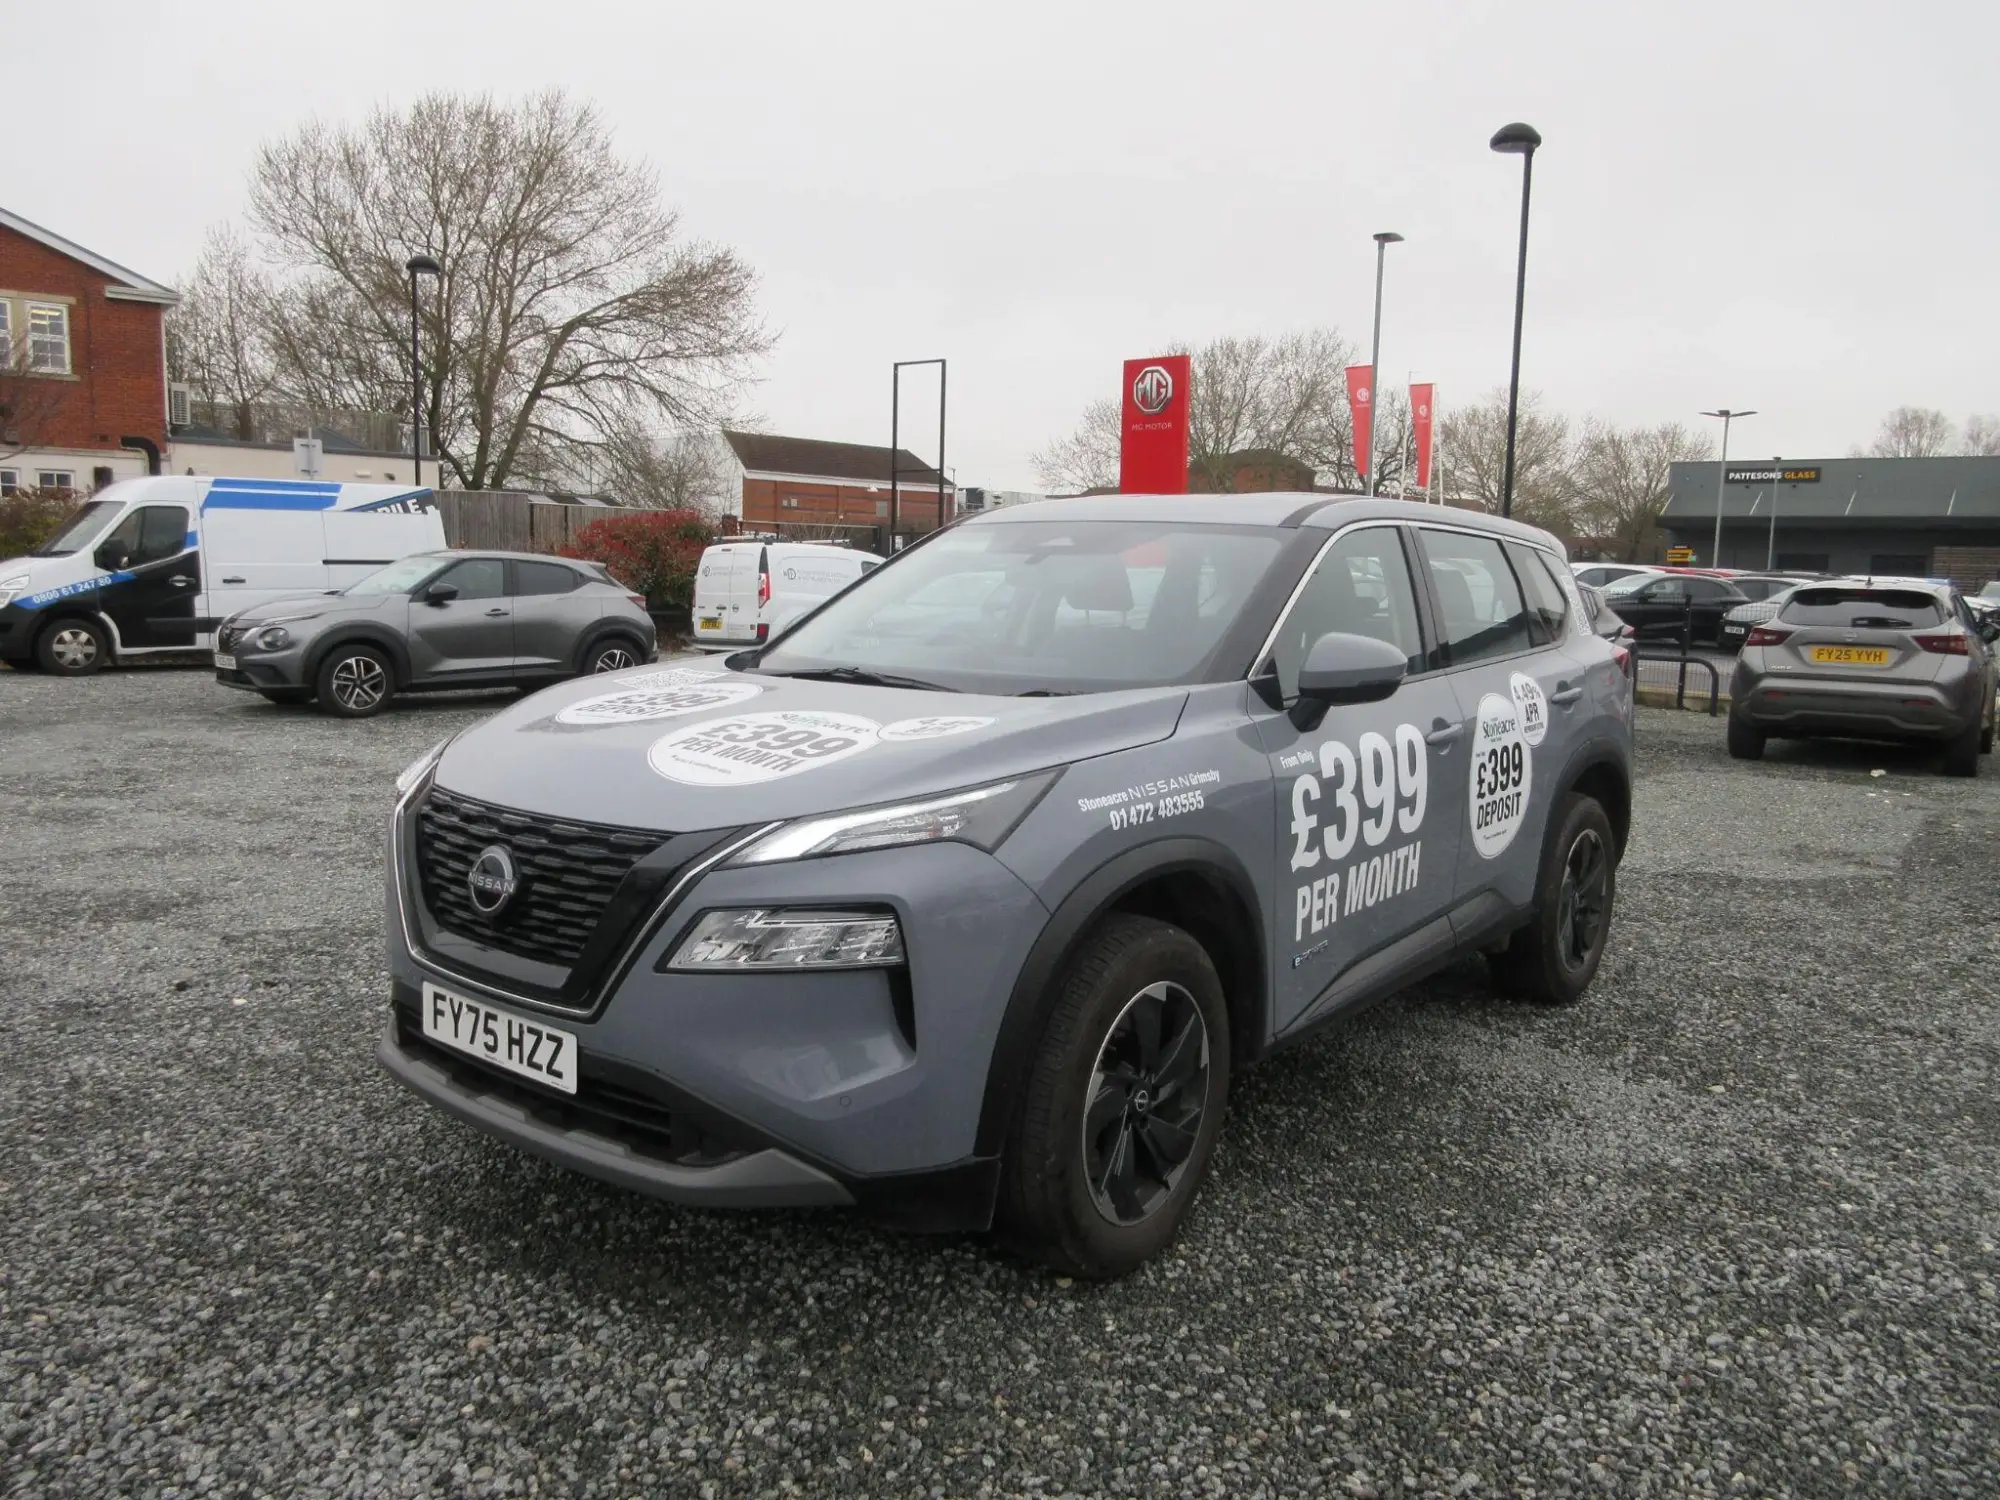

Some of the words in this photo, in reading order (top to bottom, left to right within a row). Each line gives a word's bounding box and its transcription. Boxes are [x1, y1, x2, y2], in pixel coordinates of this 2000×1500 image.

[1135, 368, 1170, 411] MG
[1132, 423, 1144, 431] MG
[1145, 422, 1173, 430] MOTOR
[1728, 471, 1782, 480] PATTESONS
[1784, 470, 1816, 479] GLASS
[32, 591, 60, 604] 0800
[62, 587, 75, 596] 61
[77, 581, 95, 593] 247
[1816, 648, 1852, 660] FY25
[1856, 650, 1883, 662] YYH
[1483, 718, 1516, 738] Stoneacre
[1525, 702, 1540, 723] APR
[669, 736, 723, 754] PER
[713, 744, 806, 772] MONTH
[695, 723, 860, 759] £399
[1279, 754, 1299, 769] From
[1297, 749, 1315, 764] Only
[1476, 742, 1523, 800] £399
[1078, 790, 1129, 812] Stoneacre
[1128, 775, 1190, 800] NISSAN
[1189, 769, 1220, 786] Grimsby
[1290, 723, 1428, 874] £399
[1109, 802, 1154, 831] 01472
[1158, 790, 1205, 819] 483555
[1476, 791, 1523, 830] DEPOSIT
[468, 871, 515, 893] NISSAN
[1295, 872, 1340, 943] PER
[1344, 841, 1422, 917] MONTH
[433, 991, 499, 1054] FY75
[507, 1019, 564, 1080] HZZ
